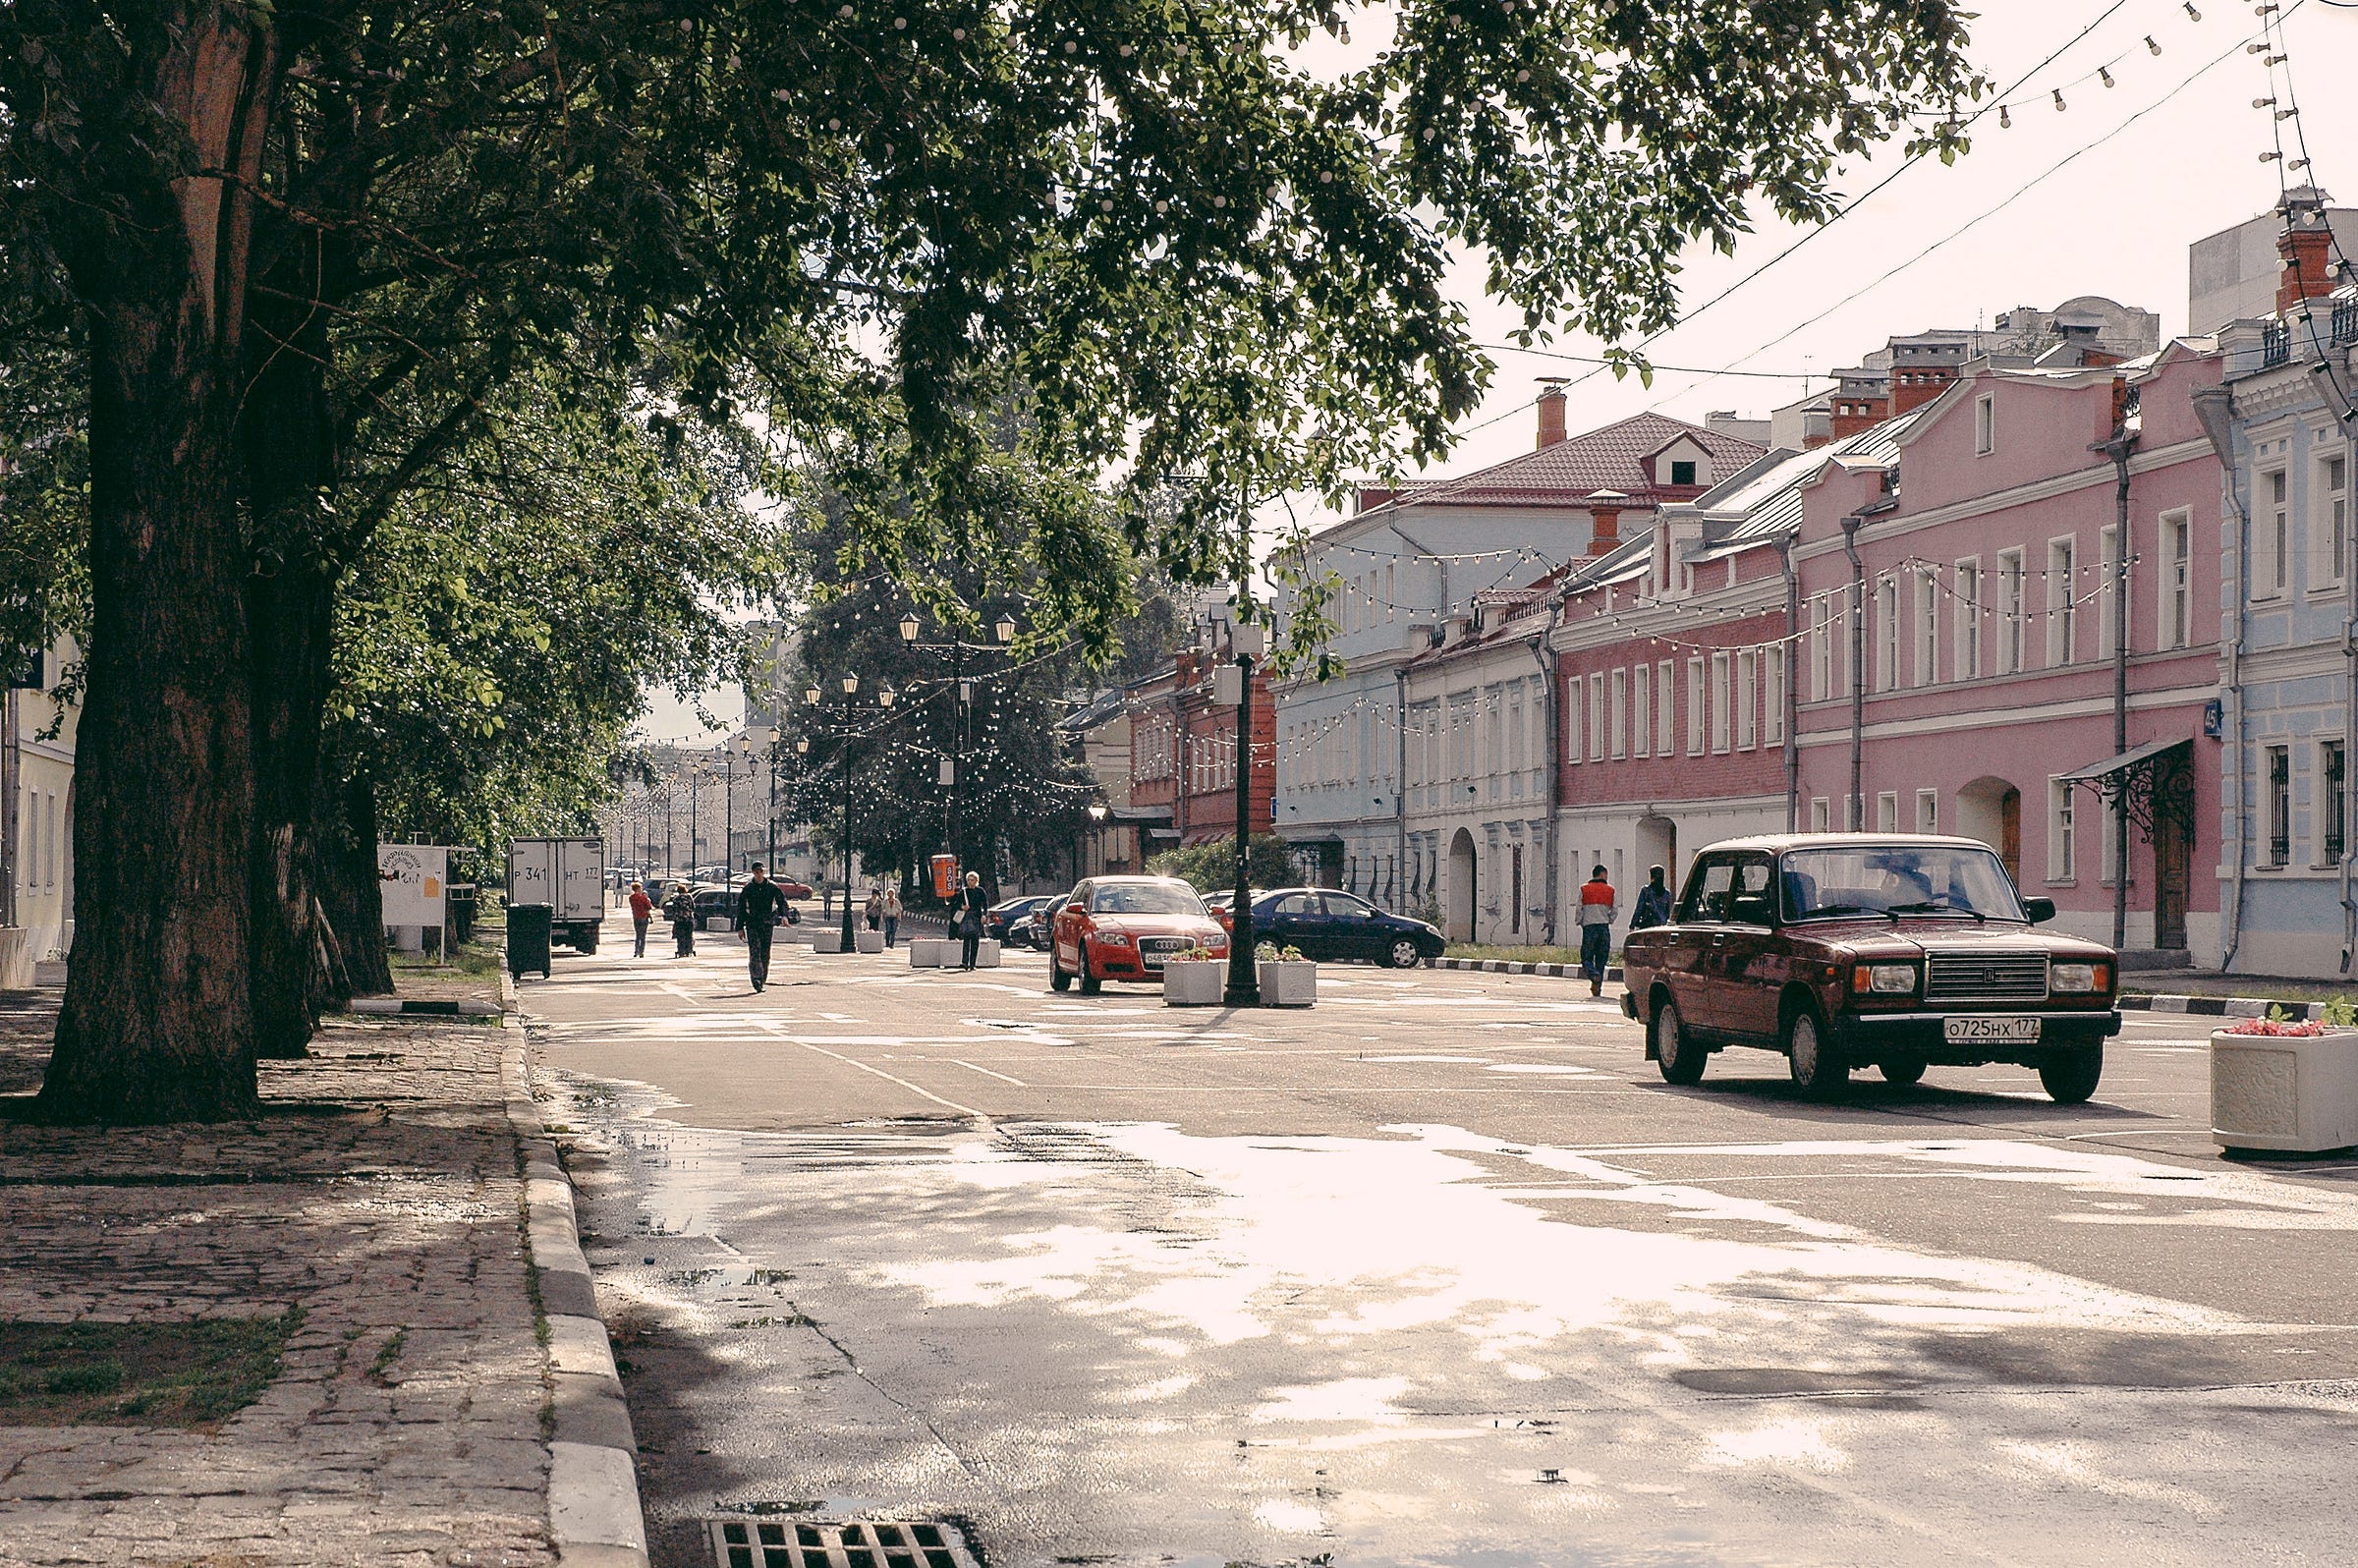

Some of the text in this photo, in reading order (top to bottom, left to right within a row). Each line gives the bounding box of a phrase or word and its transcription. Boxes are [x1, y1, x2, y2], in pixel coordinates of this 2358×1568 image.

[2205, 709, 2217, 729] 45
[514, 870, 521, 880] Р
[526, 867, 546, 881] 341
[565, 870, 579, 880] НТ
[586, 867, 598, 875] 177
[1949, 1019, 2037, 1036] О725НХ 177
